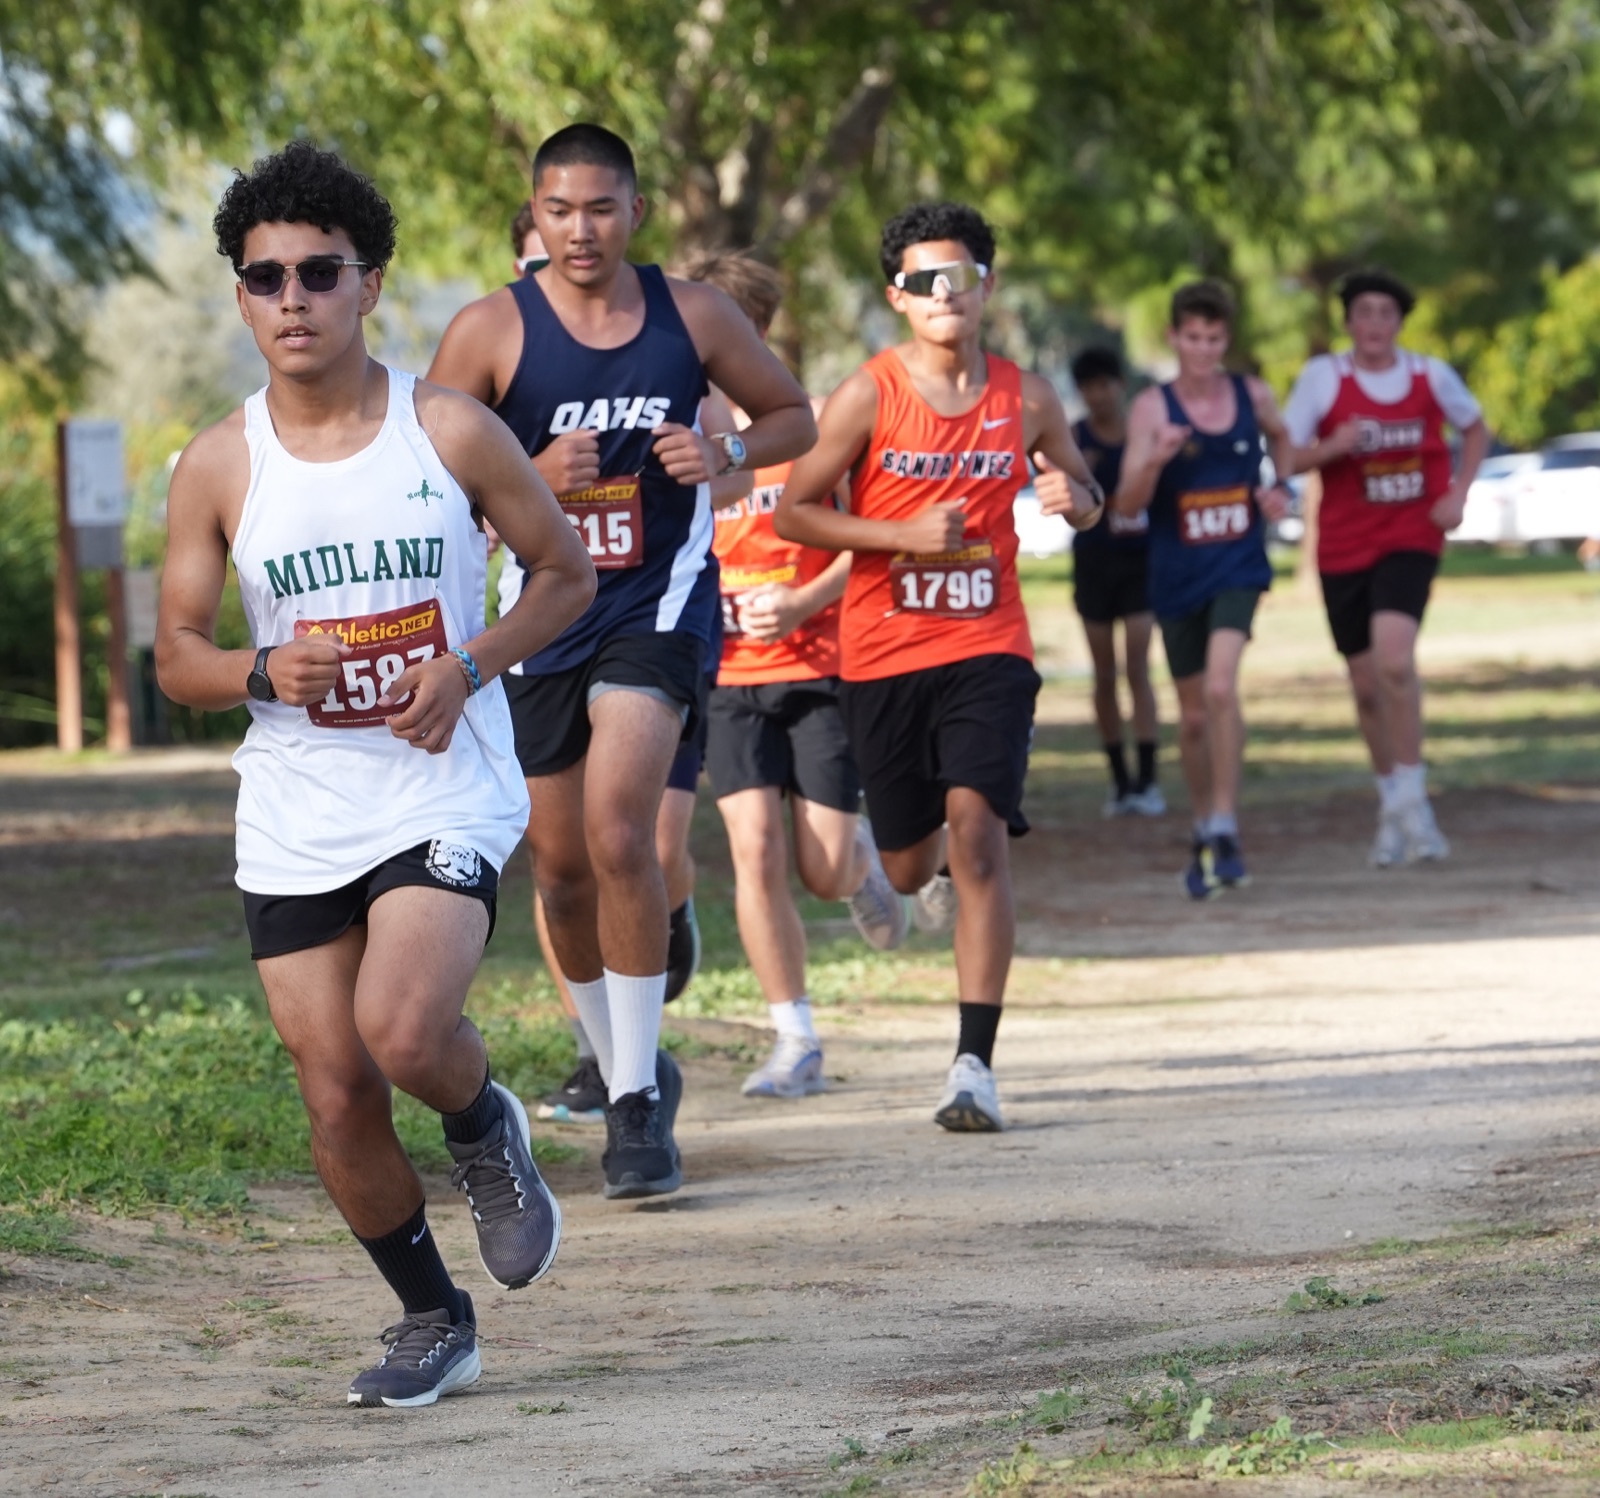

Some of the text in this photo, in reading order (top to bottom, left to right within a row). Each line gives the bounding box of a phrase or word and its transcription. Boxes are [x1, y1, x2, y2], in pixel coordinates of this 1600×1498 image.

[549, 397, 671, 435] OAHS
[882, 449, 1015, 480] SANTA YNEZ
[610, 488, 632, 498] NET
[263, 537, 444, 599] MIDLAND
[901, 568, 994, 610] 1796
[405, 614, 431, 632] NET
